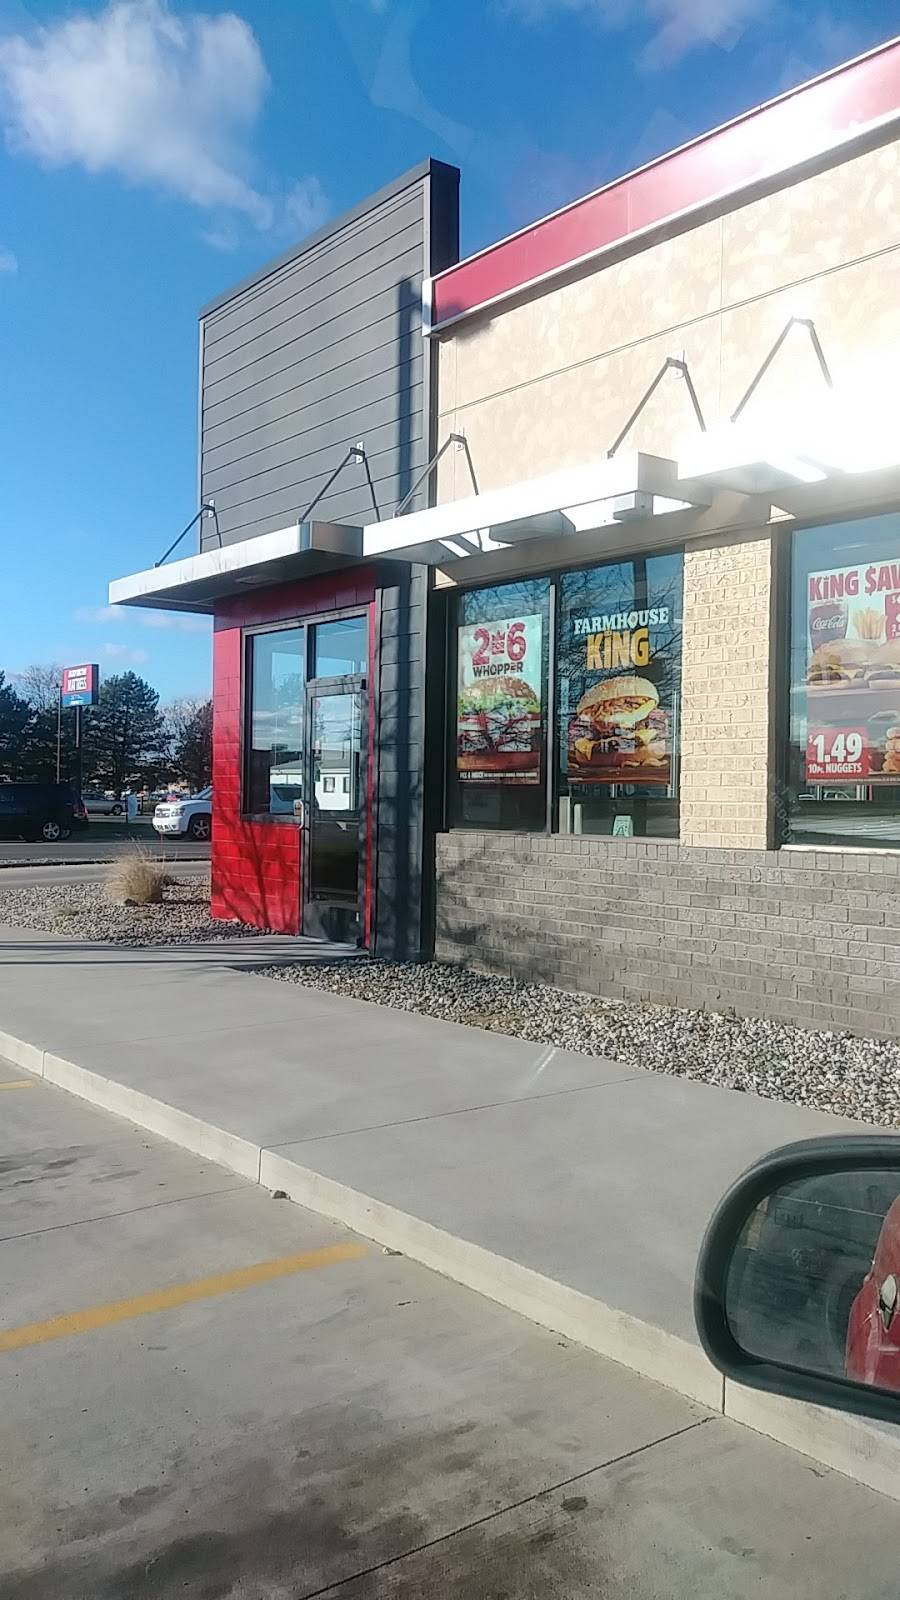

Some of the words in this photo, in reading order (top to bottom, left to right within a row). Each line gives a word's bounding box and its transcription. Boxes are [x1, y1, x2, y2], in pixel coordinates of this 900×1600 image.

[809, 571, 859, 601] KING
[574, 607, 669, 635] FARMHOUSE
[472, 628, 490, 666] 2
[586, 628, 650, 670] KING
[473, 661, 524, 678] WHOPPER
[808, 732, 863, 763] $1.49
[825, 762, 863, 774] NUGGETS
